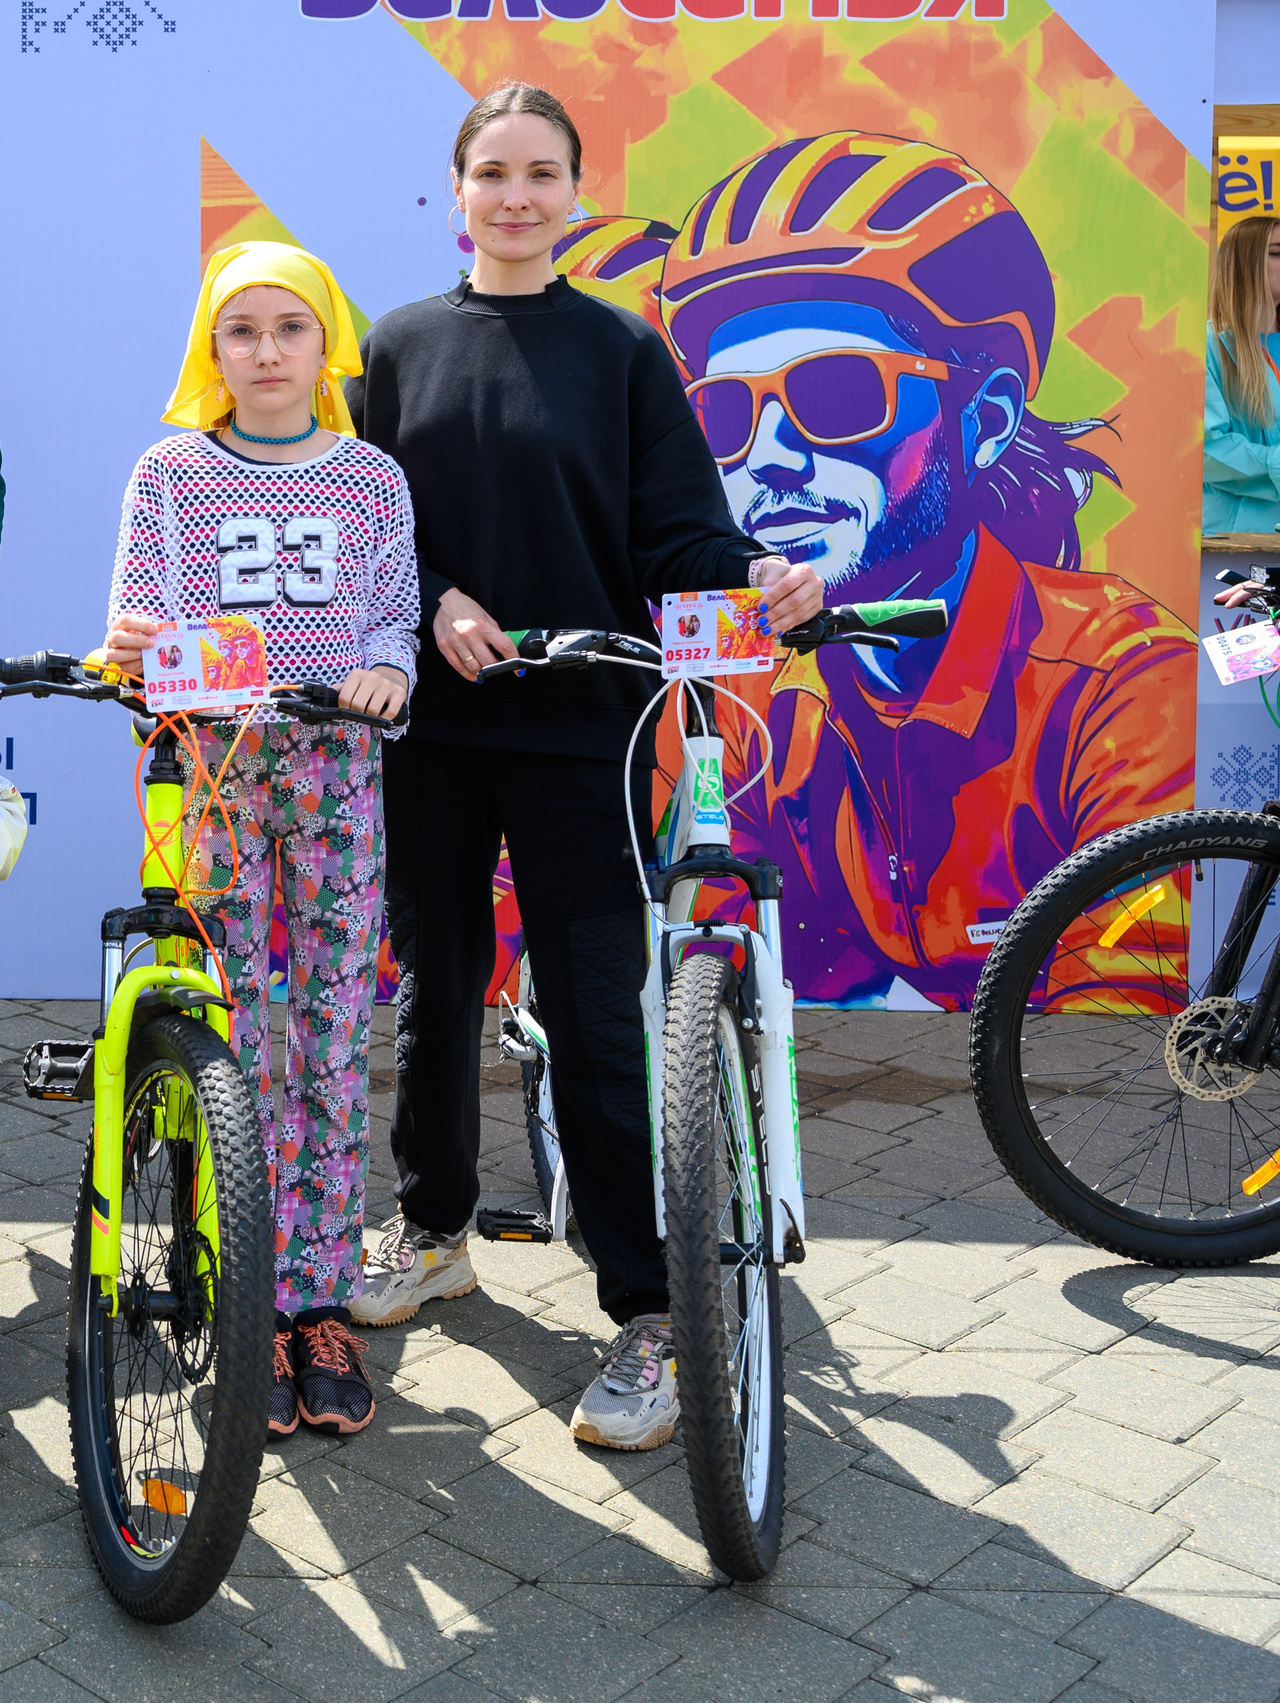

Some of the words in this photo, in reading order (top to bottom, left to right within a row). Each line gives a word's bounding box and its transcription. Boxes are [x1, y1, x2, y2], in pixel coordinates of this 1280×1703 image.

[216, 517, 340, 611] 23
[665, 647, 711, 662] 05327
[147, 678, 198, 695] 05330
[1141, 835, 1269, 861] CHAOYANG
